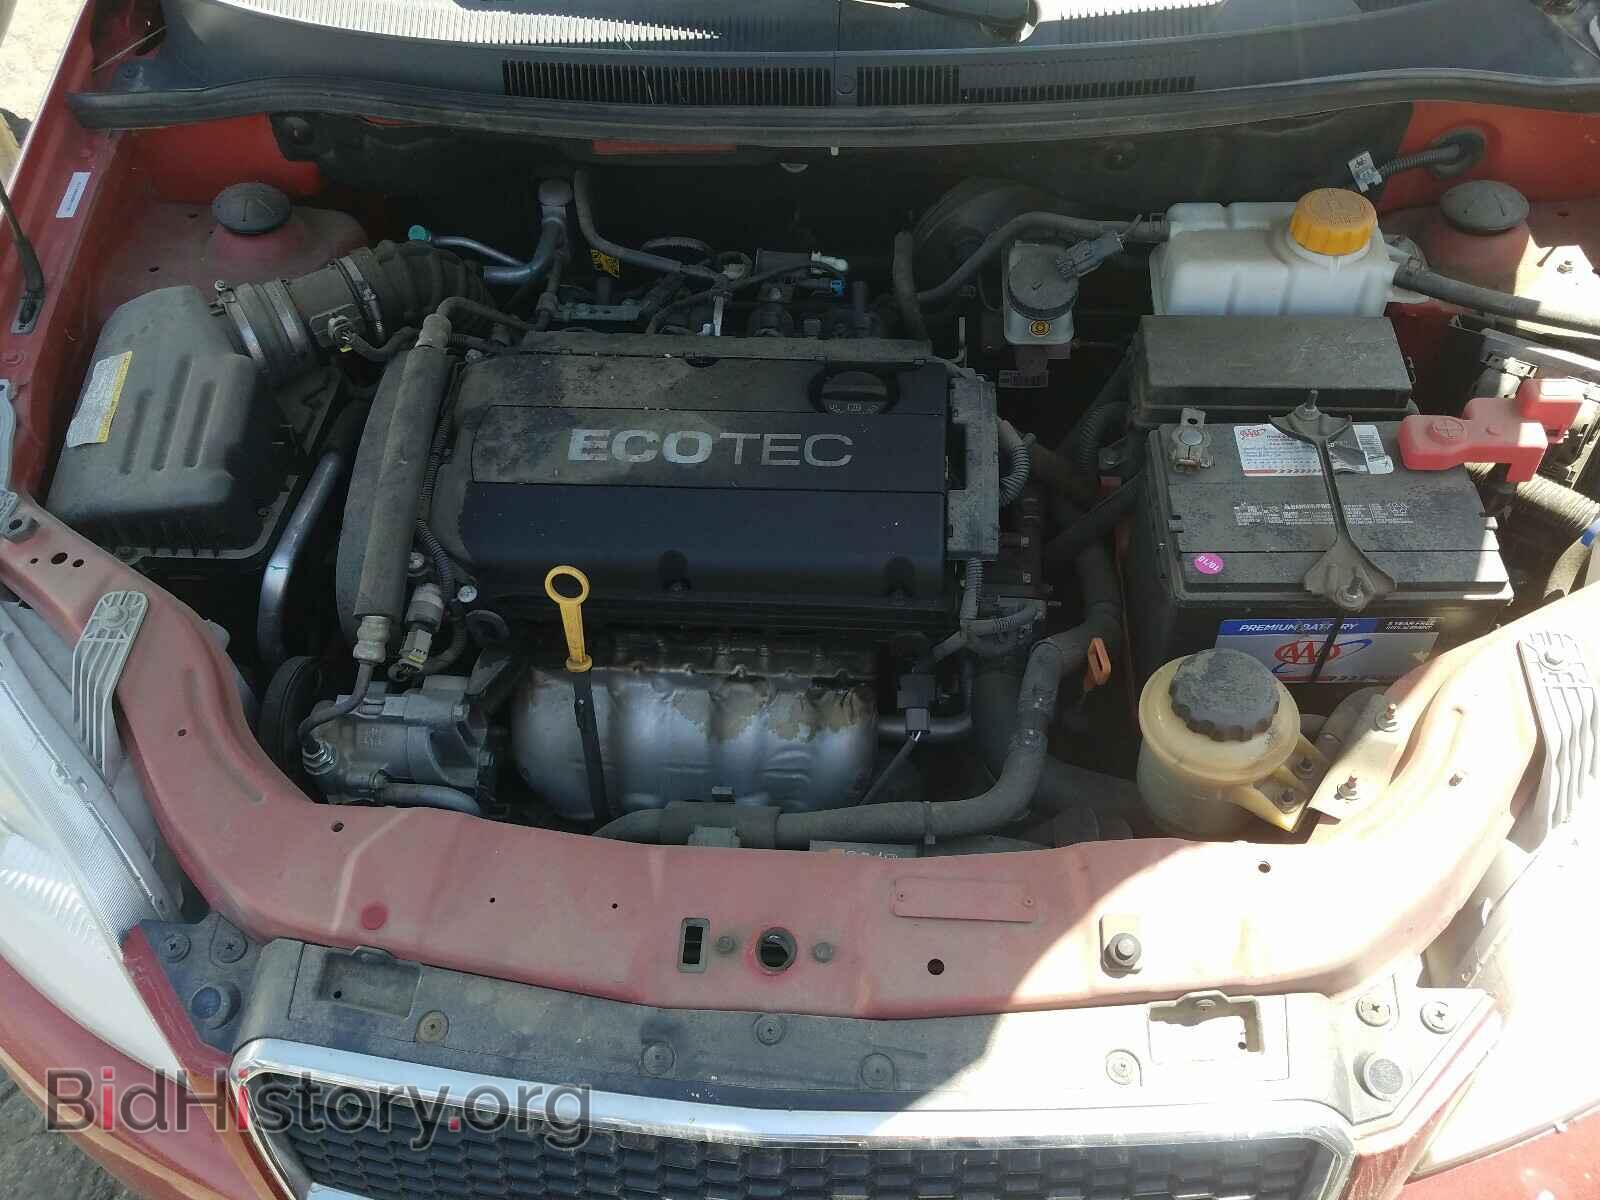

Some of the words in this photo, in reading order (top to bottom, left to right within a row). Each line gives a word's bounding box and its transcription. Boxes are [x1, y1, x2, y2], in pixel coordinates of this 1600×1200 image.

[567, 428, 853, 467] ECOTEC
[1239, 623, 1298, 632] PREMIUM
[1303, 623, 1360, 632] BATTRY
